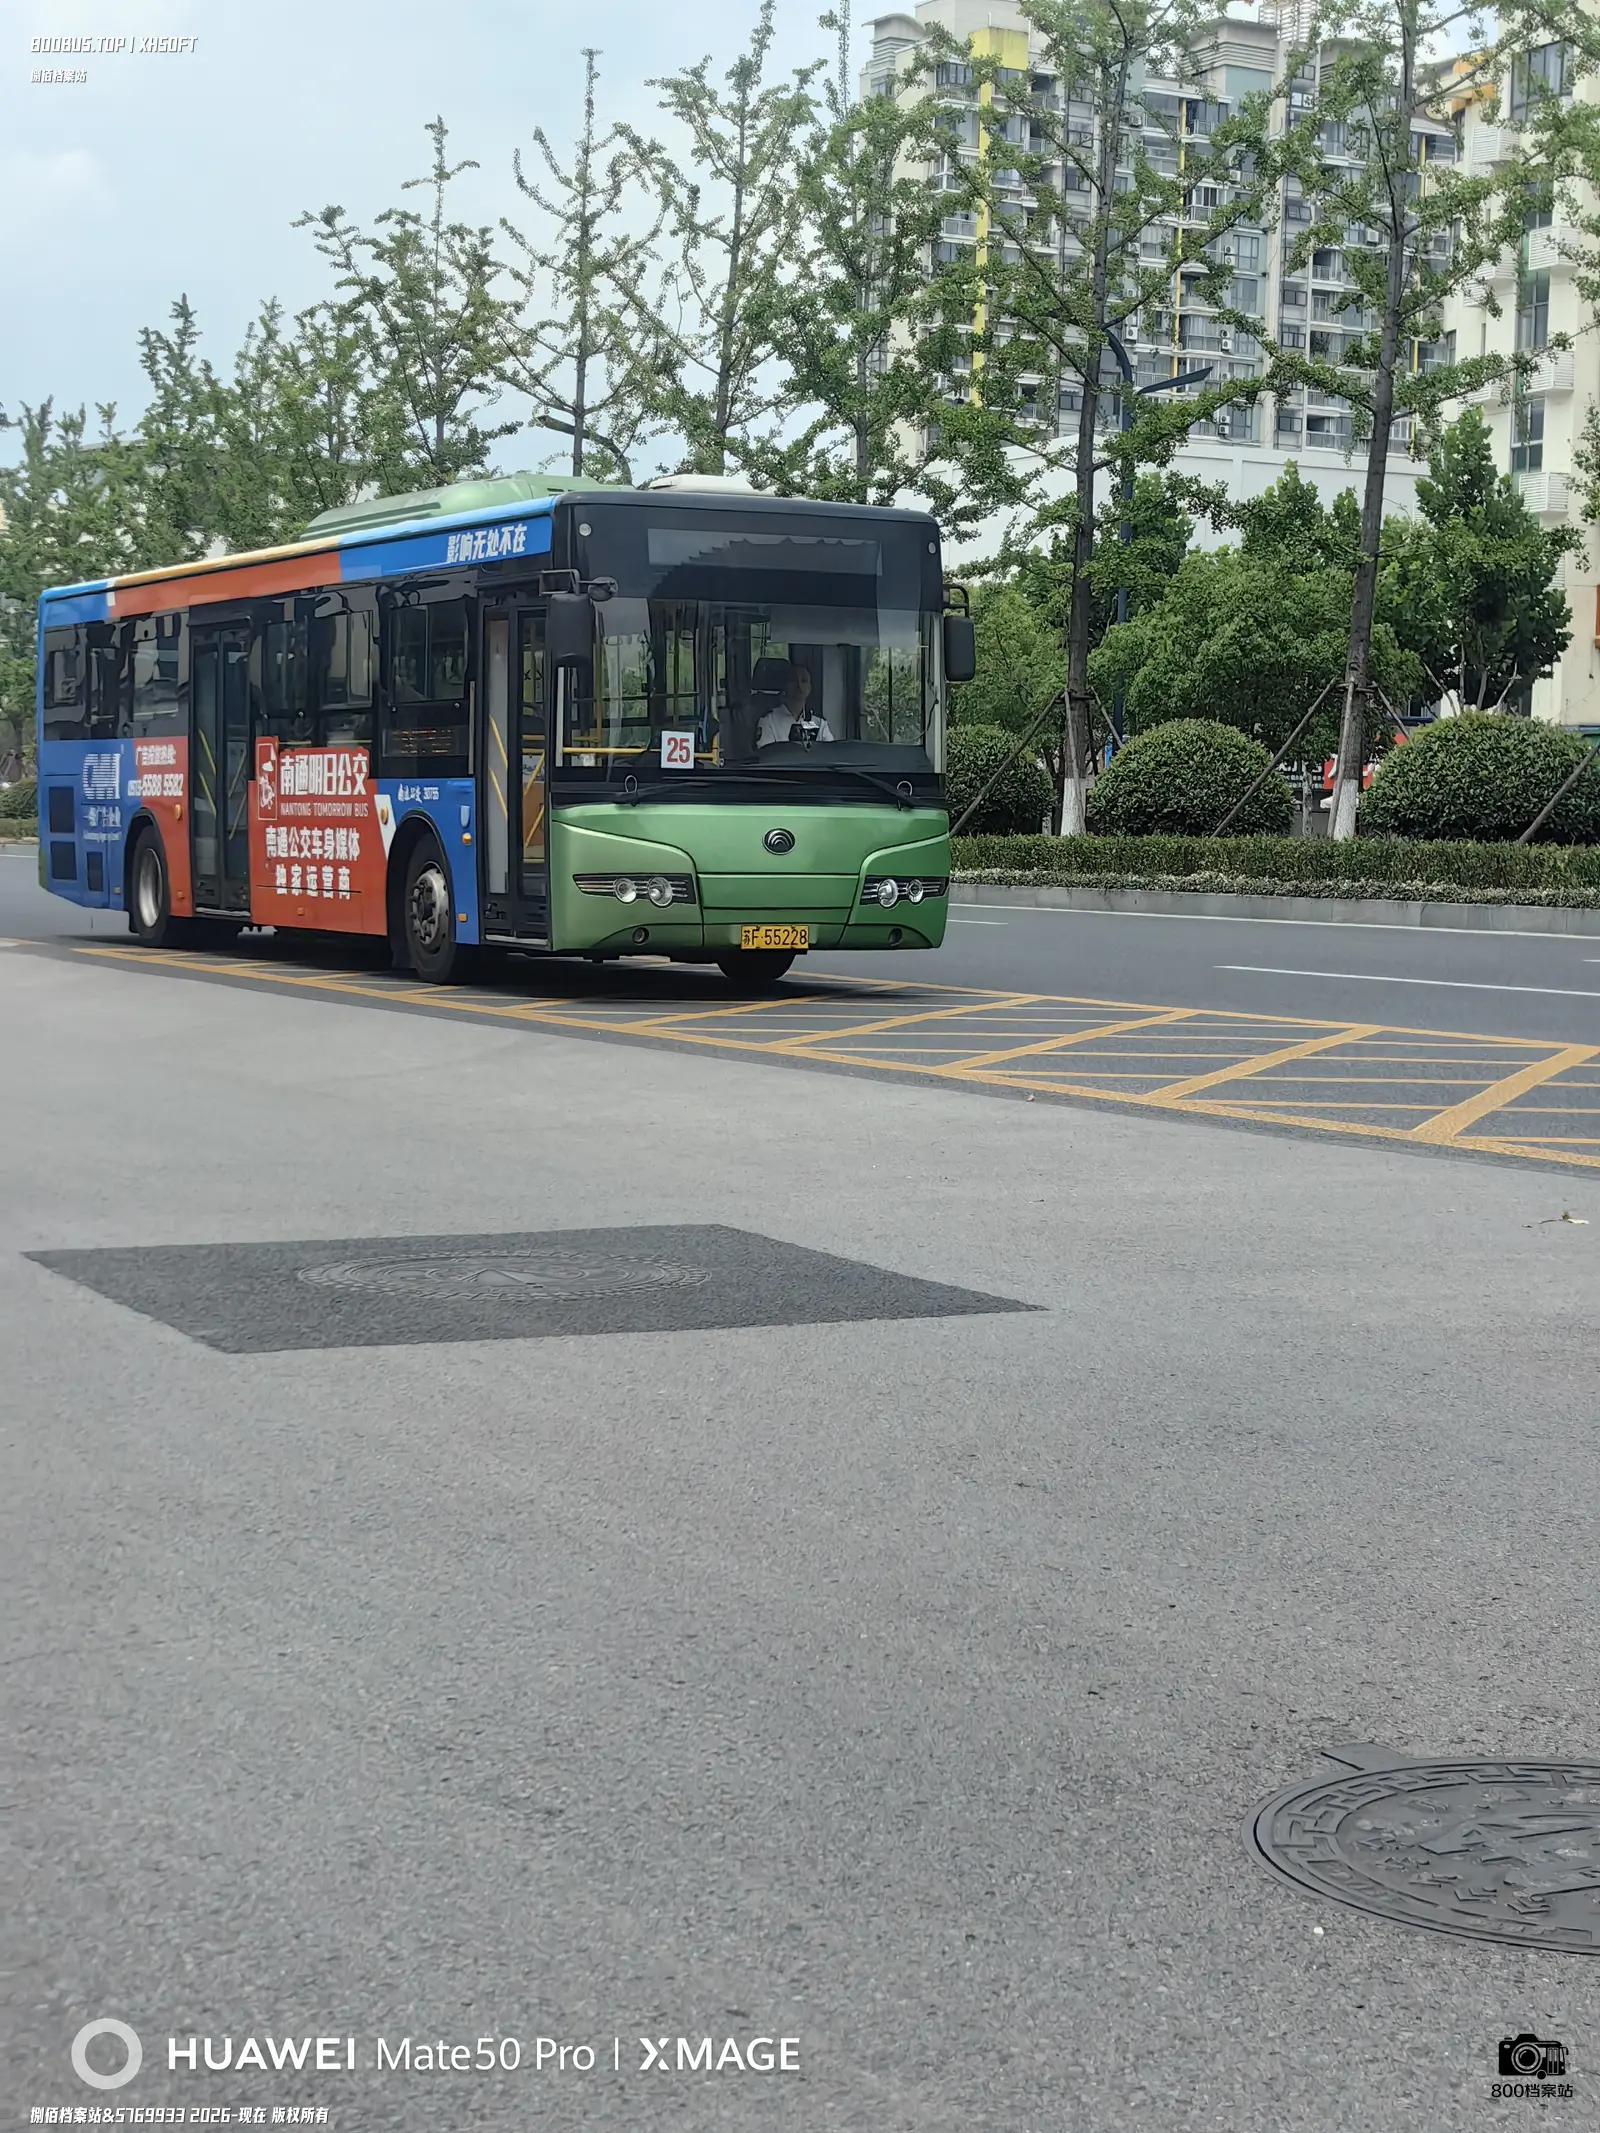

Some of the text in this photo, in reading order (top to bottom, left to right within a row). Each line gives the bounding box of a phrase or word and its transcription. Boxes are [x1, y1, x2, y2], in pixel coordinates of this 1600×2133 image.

[446, 523, 528, 563] 影响无处不在
[666, 737, 691, 763] 25
[280, 752, 368, 796] 南通明日公交
[280, 802, 369, 817] NANTONG TOMORROW BUS
[265, 825, 360, 861] 南通公交车身媒体
[276, 863, 351, 900] 独家运营商
